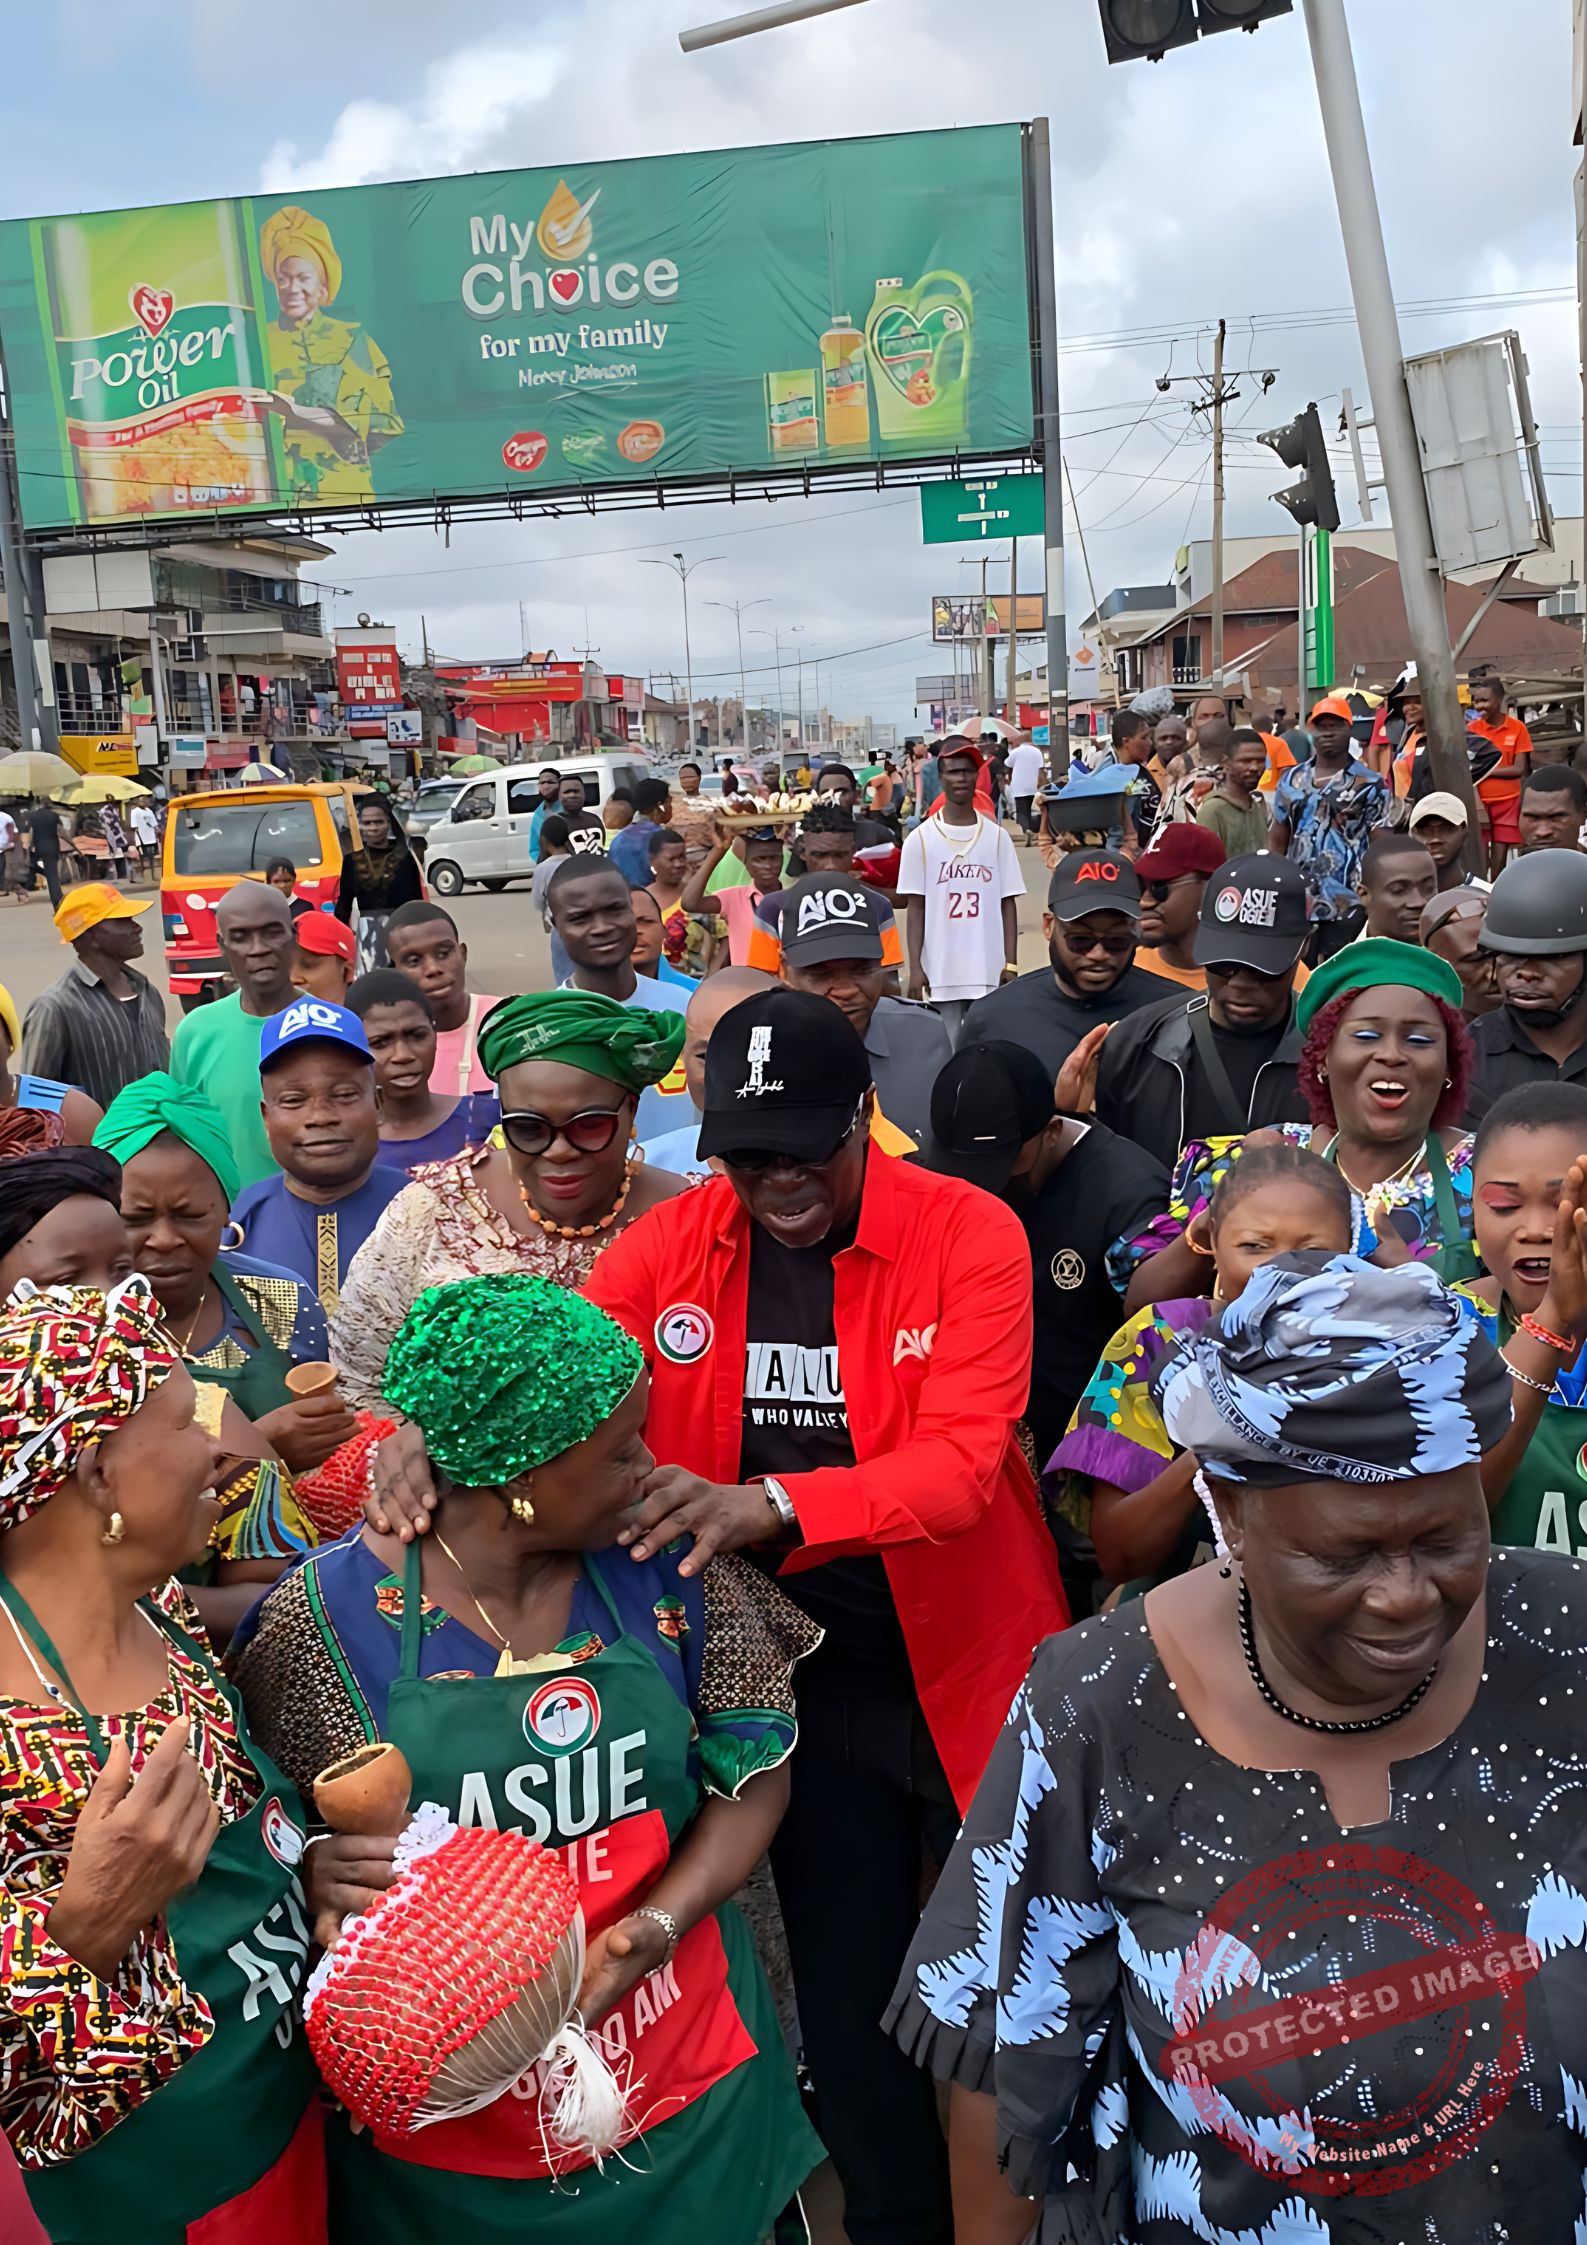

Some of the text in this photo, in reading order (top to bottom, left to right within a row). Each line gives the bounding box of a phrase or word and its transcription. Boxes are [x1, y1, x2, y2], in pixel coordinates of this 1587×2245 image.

[469, 214, 535, 261] My
[462, 252, 679, 315] Choice
[70, 323, 236, 400] Power
[480, 319, 668, 359] for my family
[138, 371, 180, 409] Oil
[949, 892, 980, 918] 23
[751, 1408, 788, 1425] WHO
[458, 1729, 647, 1845] ASUE
[634, 1960, 682, 2039] AM
